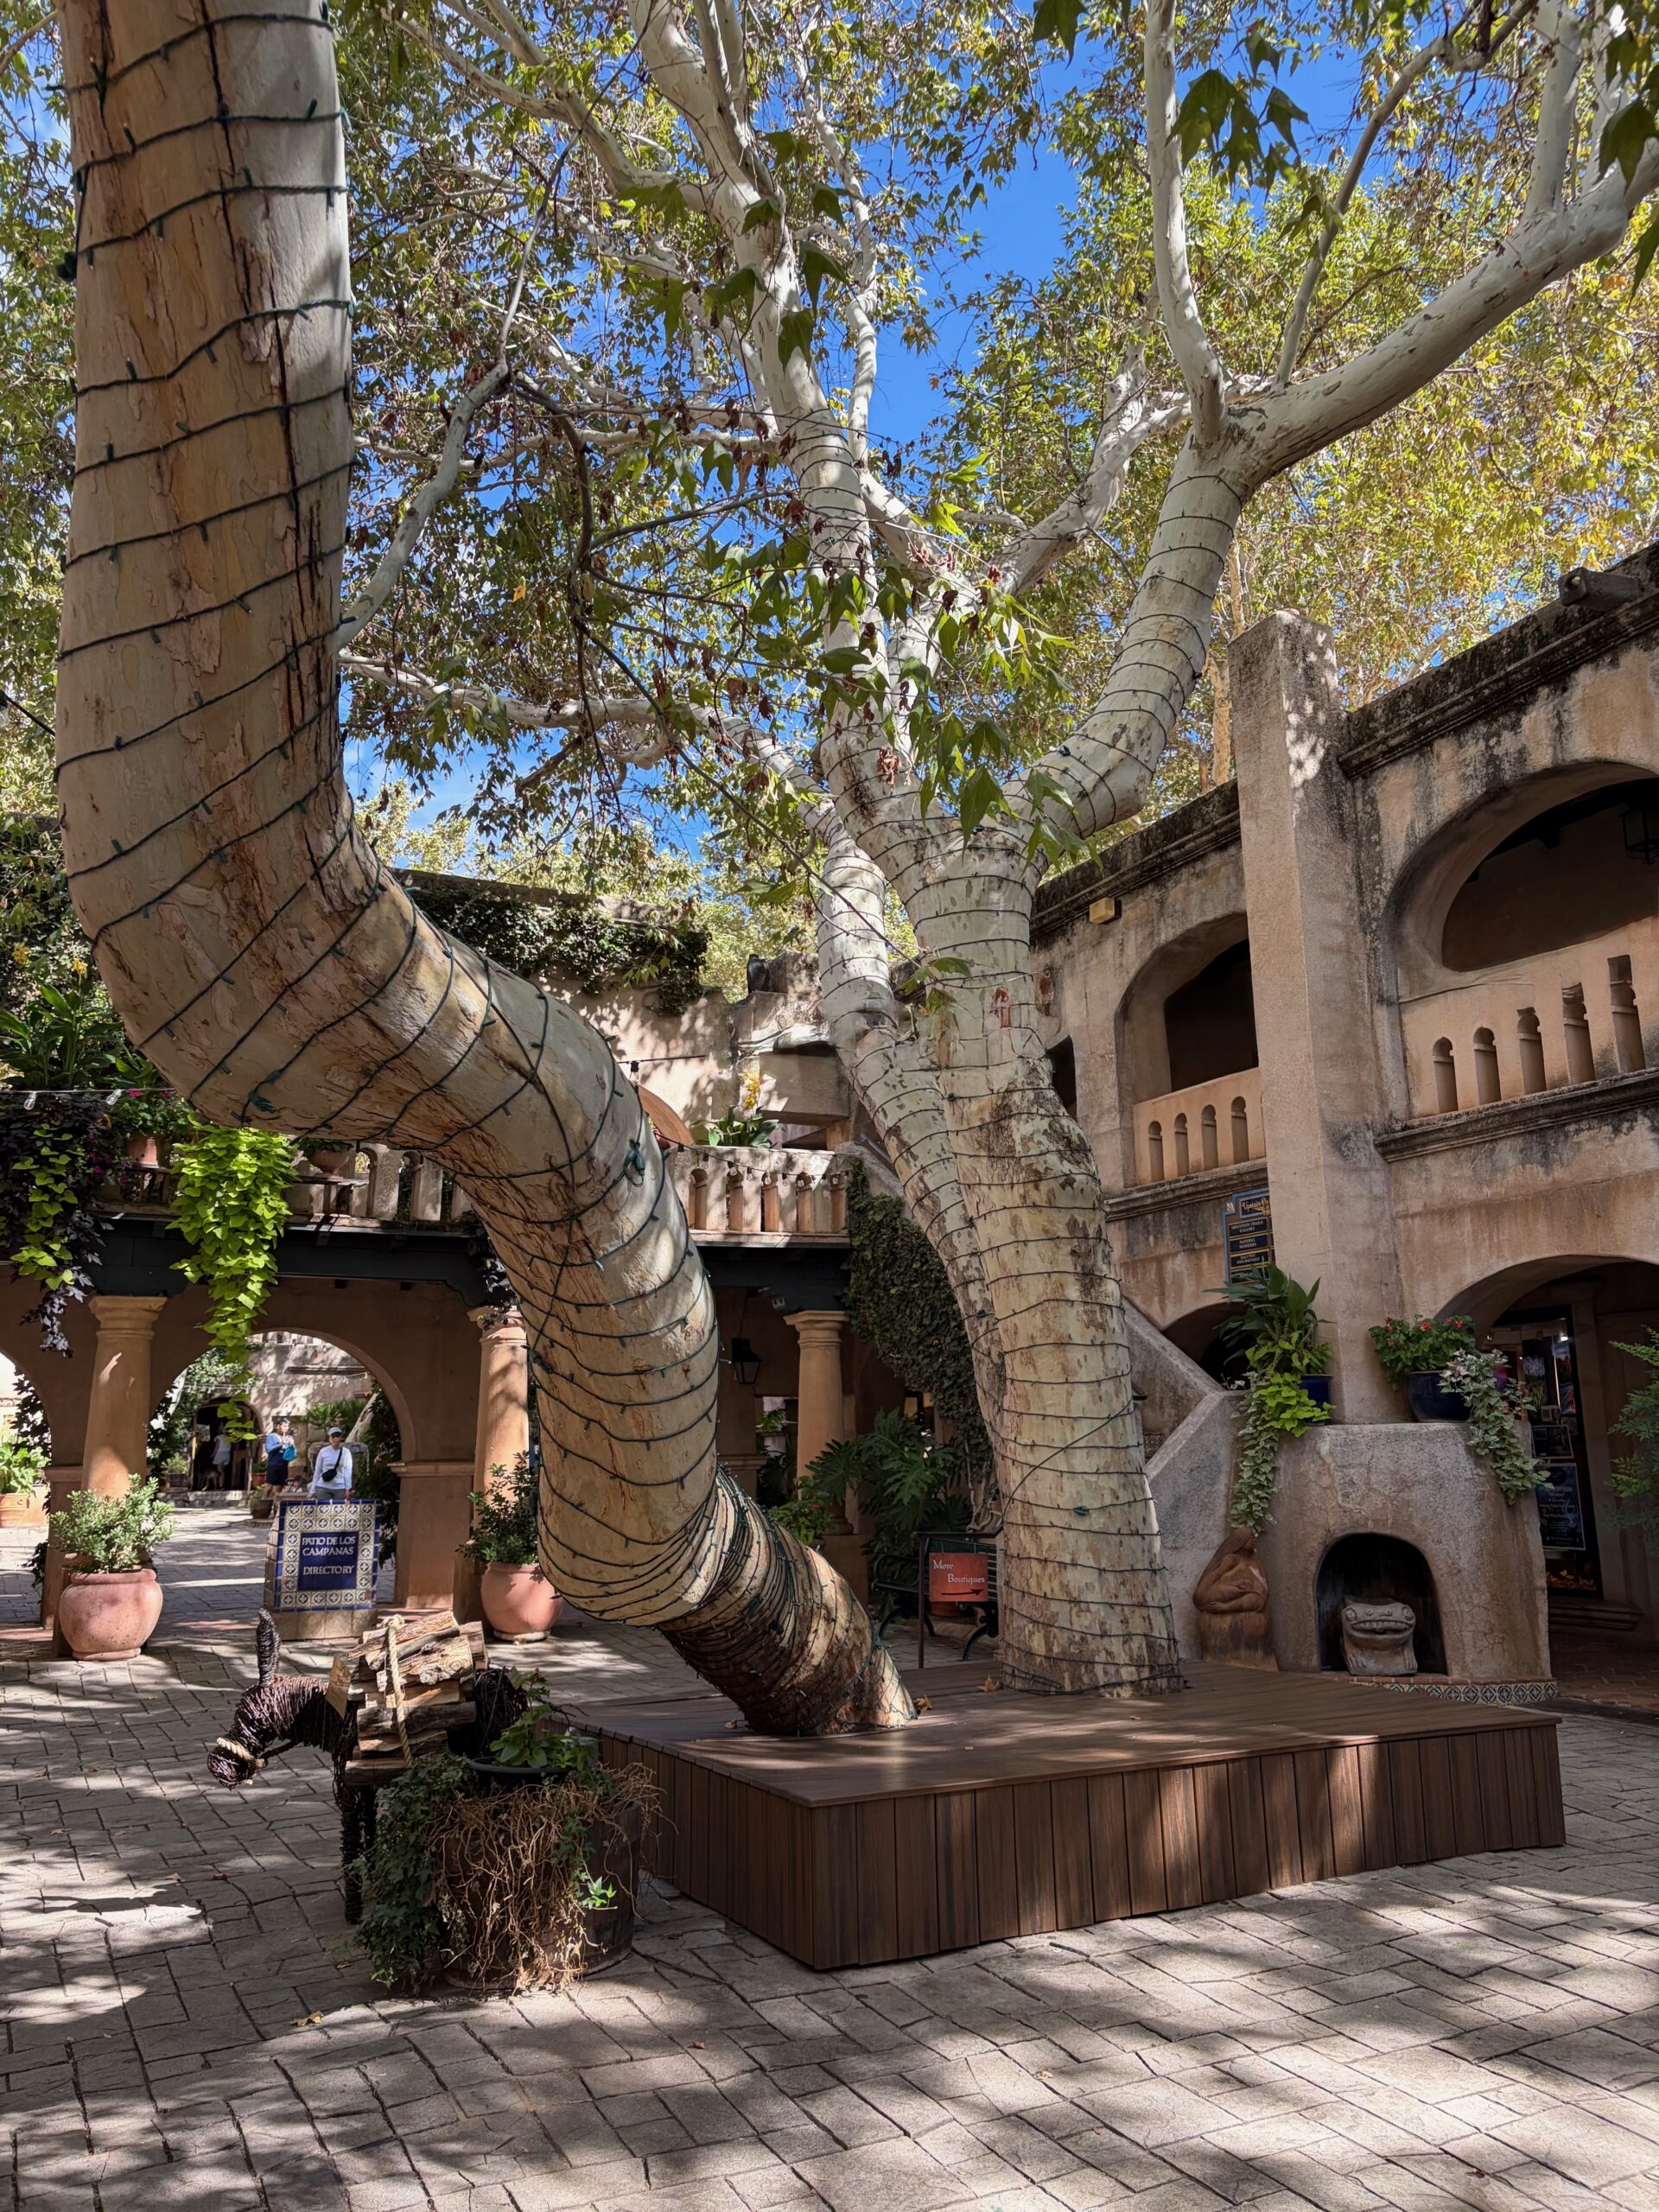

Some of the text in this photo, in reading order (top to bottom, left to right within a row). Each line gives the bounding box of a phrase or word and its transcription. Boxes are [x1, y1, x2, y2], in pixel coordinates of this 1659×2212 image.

[326, 1536, 338, 1545] DE
[340, 1536, 356, 1545] LOS
[933, 1560, 954, 1570] More
[303, 1566, 353, 1574] DIRECTORY
[947, 1573, 985, 1585] Boutiques
